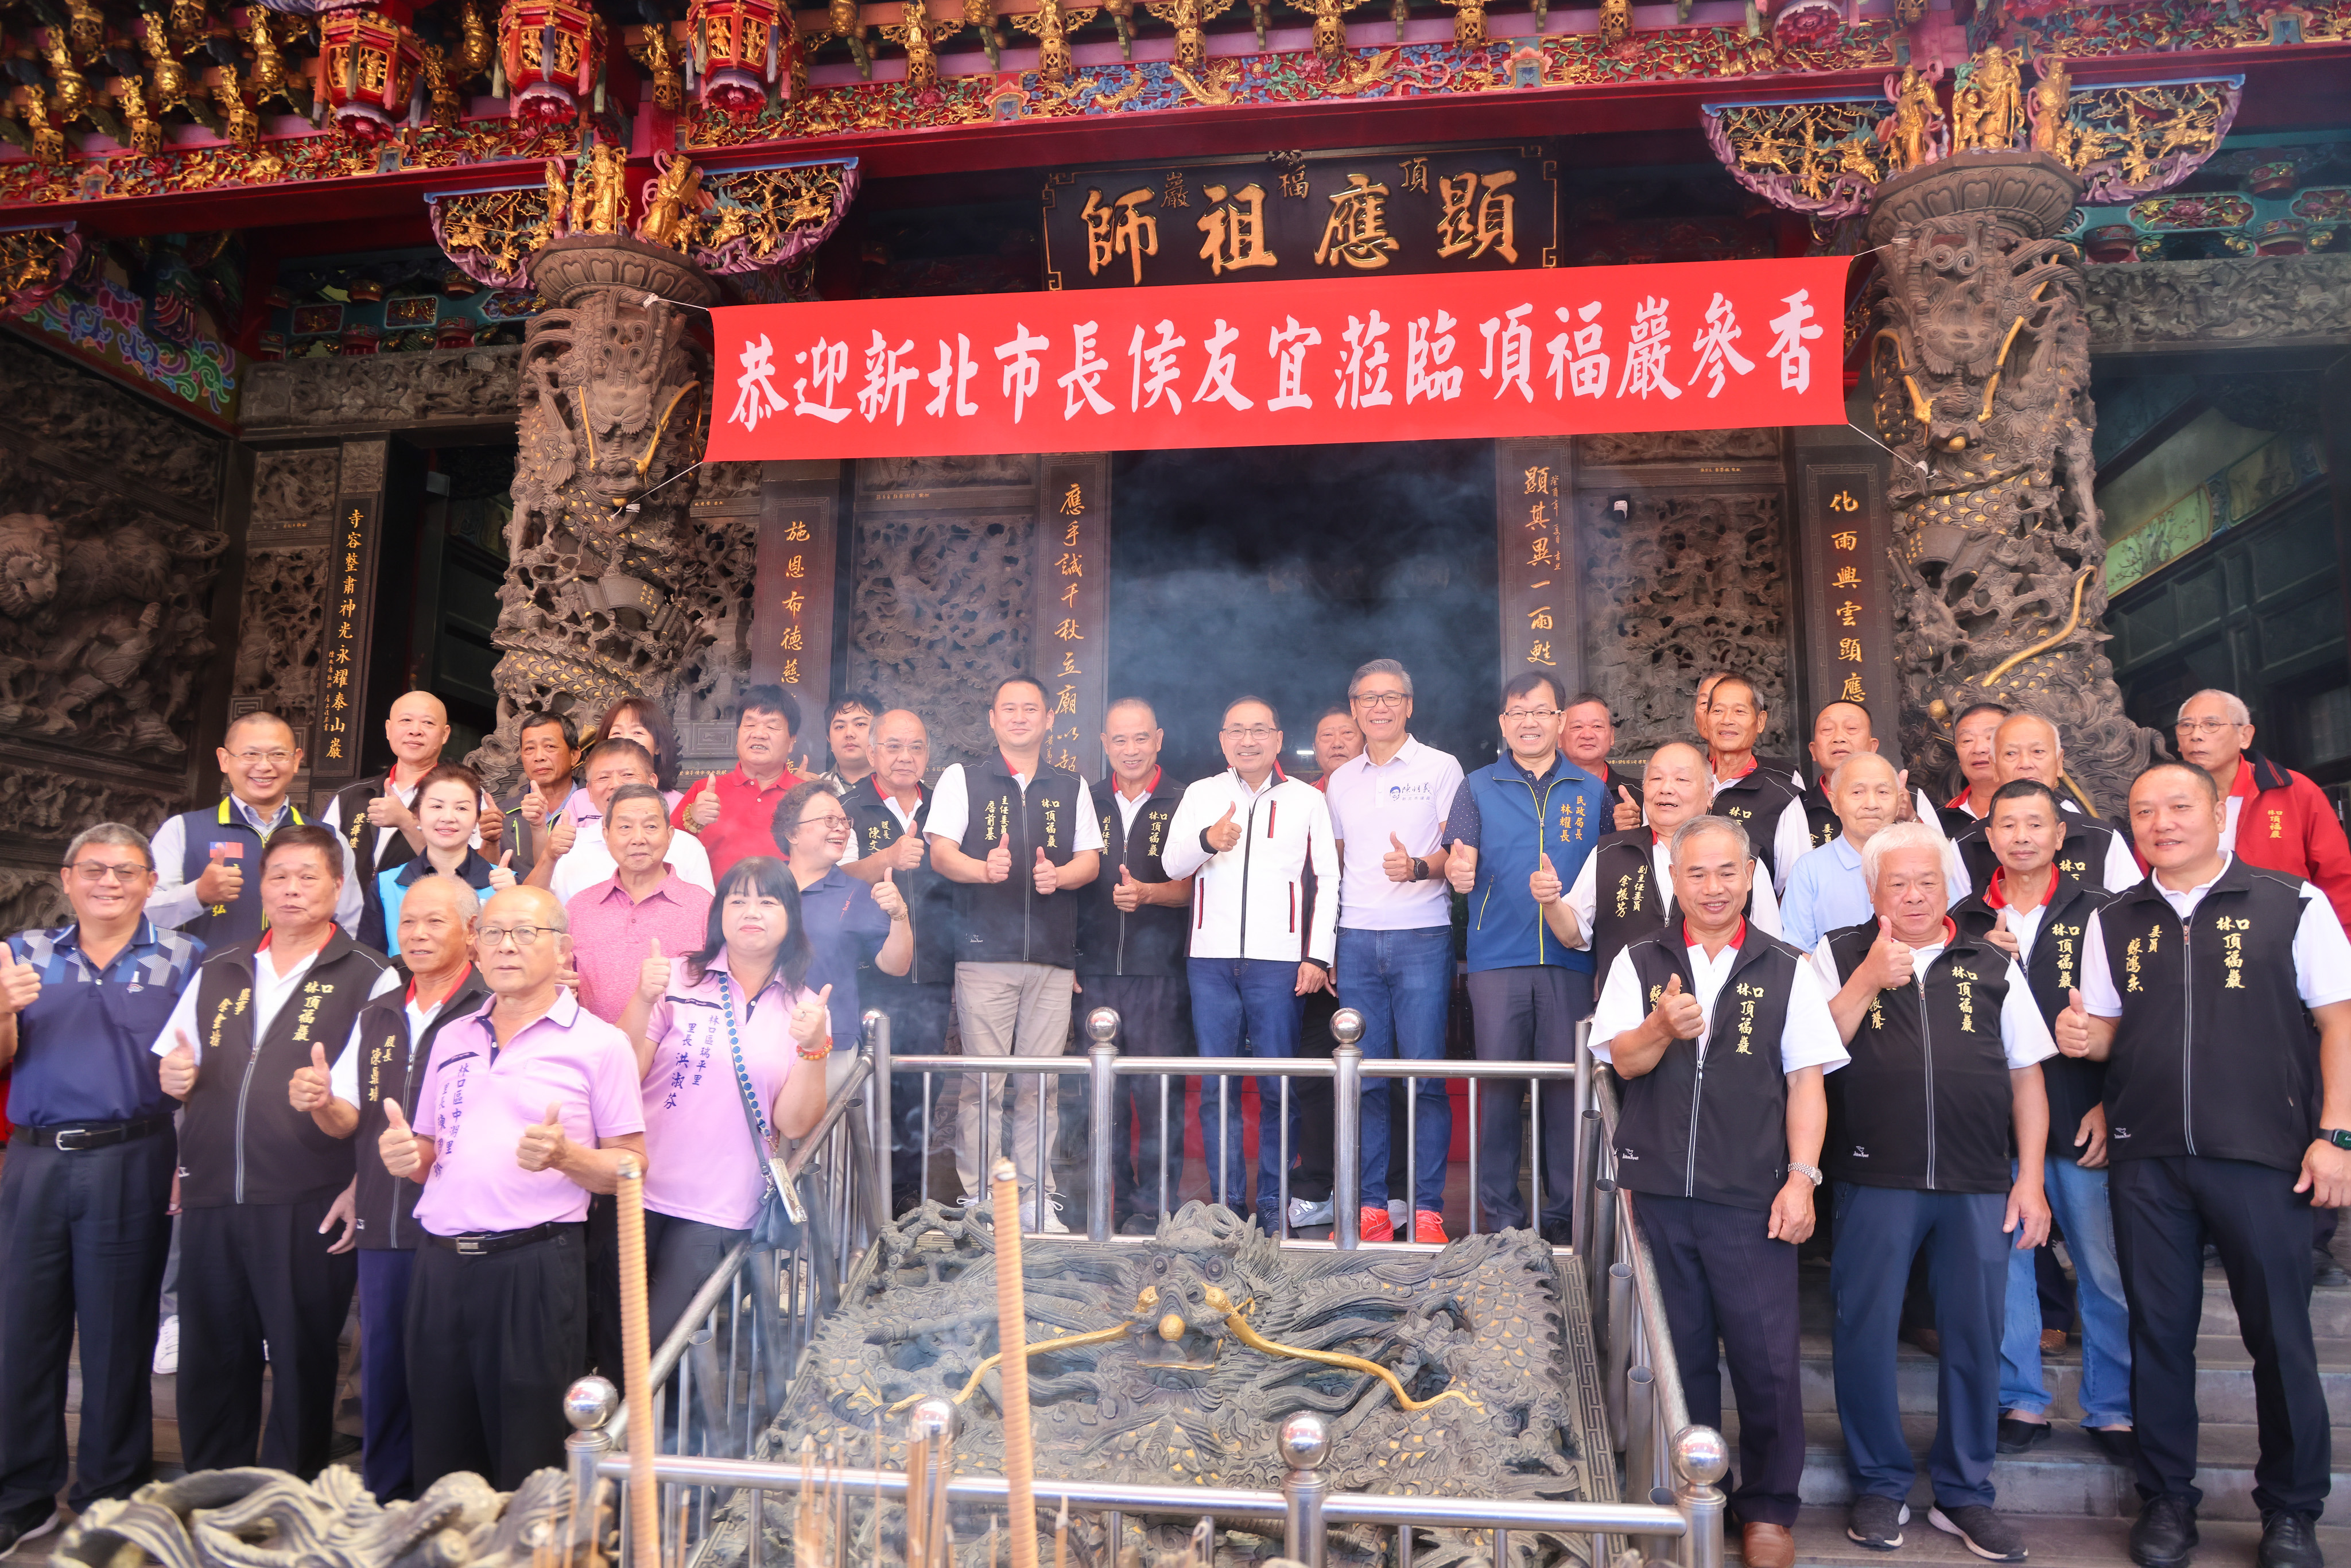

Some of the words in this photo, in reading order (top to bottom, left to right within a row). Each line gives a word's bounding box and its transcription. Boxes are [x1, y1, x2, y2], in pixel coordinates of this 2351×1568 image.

[1041, 798, 1060, 808] 林口
[999, 795, 1009, 835] 主任委員
[1149, 811, 1167, 820] 林口
[1576, 795, 1586, 840] 民政局長
[1729, 806, 1752, 818] 林口
[1559, 804, 1573, 842] 林耀長
[868, 827, 882, 854] 陳文
[2059, 860, 2086, 872] 林口
[1632, 865, 1648, 912] 副主任委員
[2052, 923, 2080, 936] 林口
[2216, 916, 2250, 932] 林口
[2148, 925, 2162, 953] 委員
[1952, 966, 1978, 980] 林口
[304, 981, 335, 993] 林口
[1737, 983, 1764, 999] 林口
[692, 1015, 720, 1086] 林口區瑞平里
